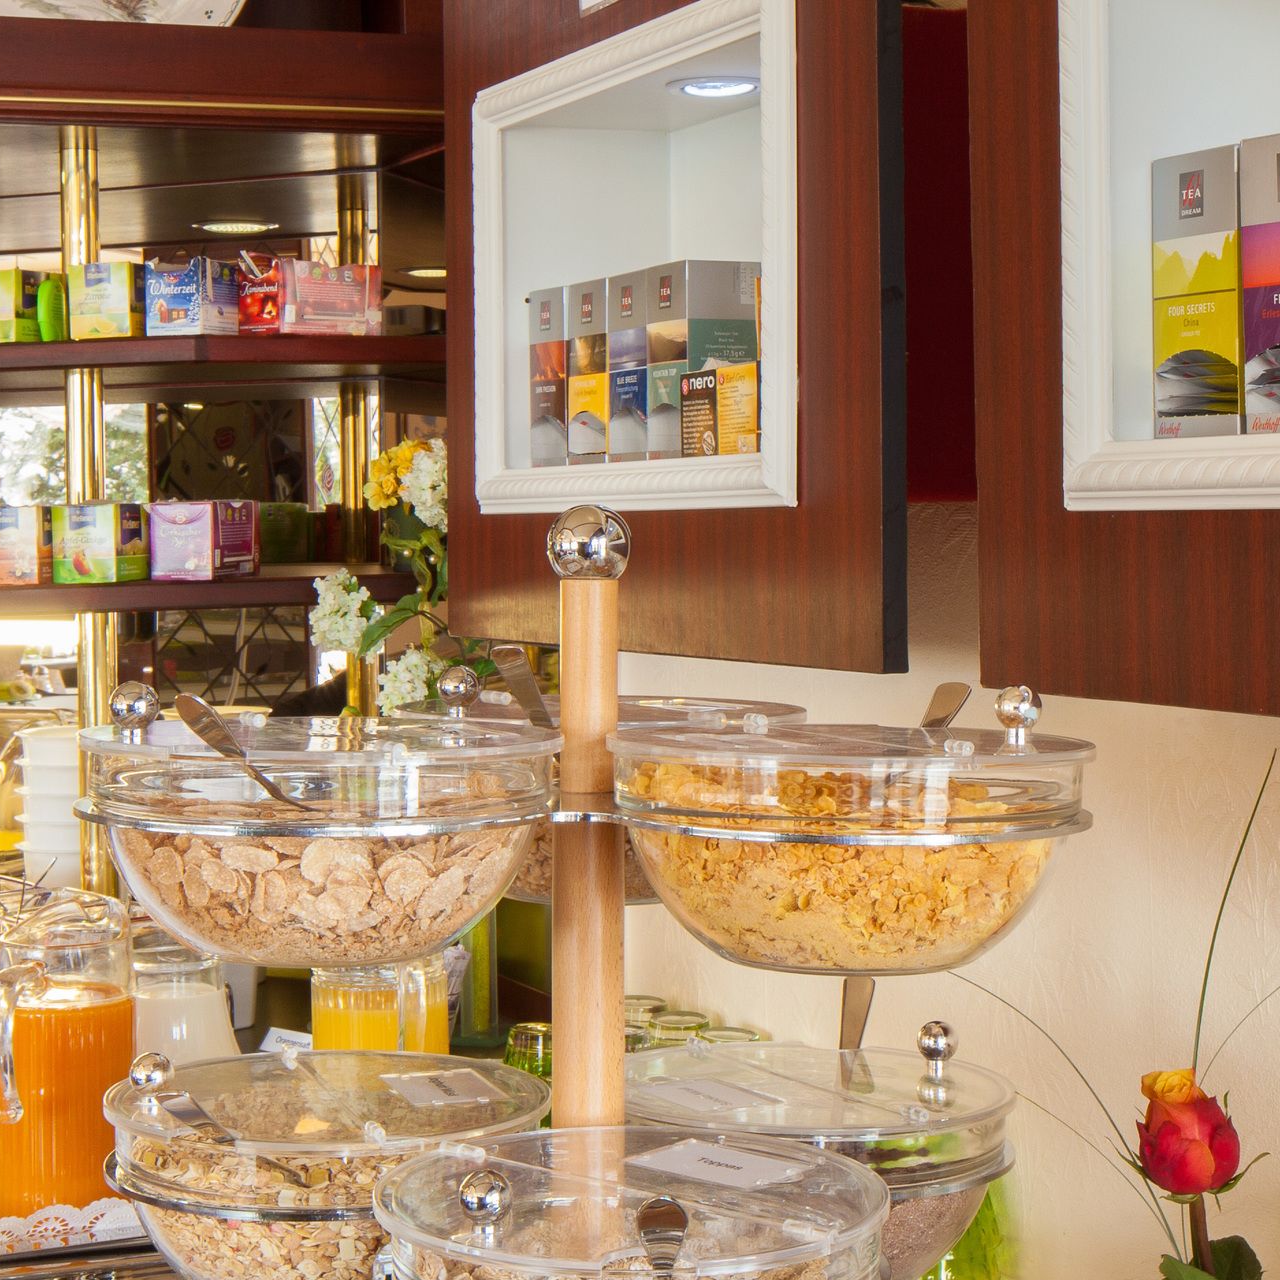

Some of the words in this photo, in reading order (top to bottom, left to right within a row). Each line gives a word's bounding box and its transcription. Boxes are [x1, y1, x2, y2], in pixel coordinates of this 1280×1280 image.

[1181, 188, 1201, 200] TEA
[148, 280, 196, 295] Winterzeit
[240, 282, 278, 296] Kaminabend
[660, 288, 671, 296] TEA
[1168, 305, 1185, 317] FOUR
[1186, 302, 1216, 315] SECRETS
[1183, 318, 1200, 328] China
[689, 376, 715, 391] nero
[1251, 416, 1280, 433] Westhoff
[696, 1156, 744, 1171] Toppas
